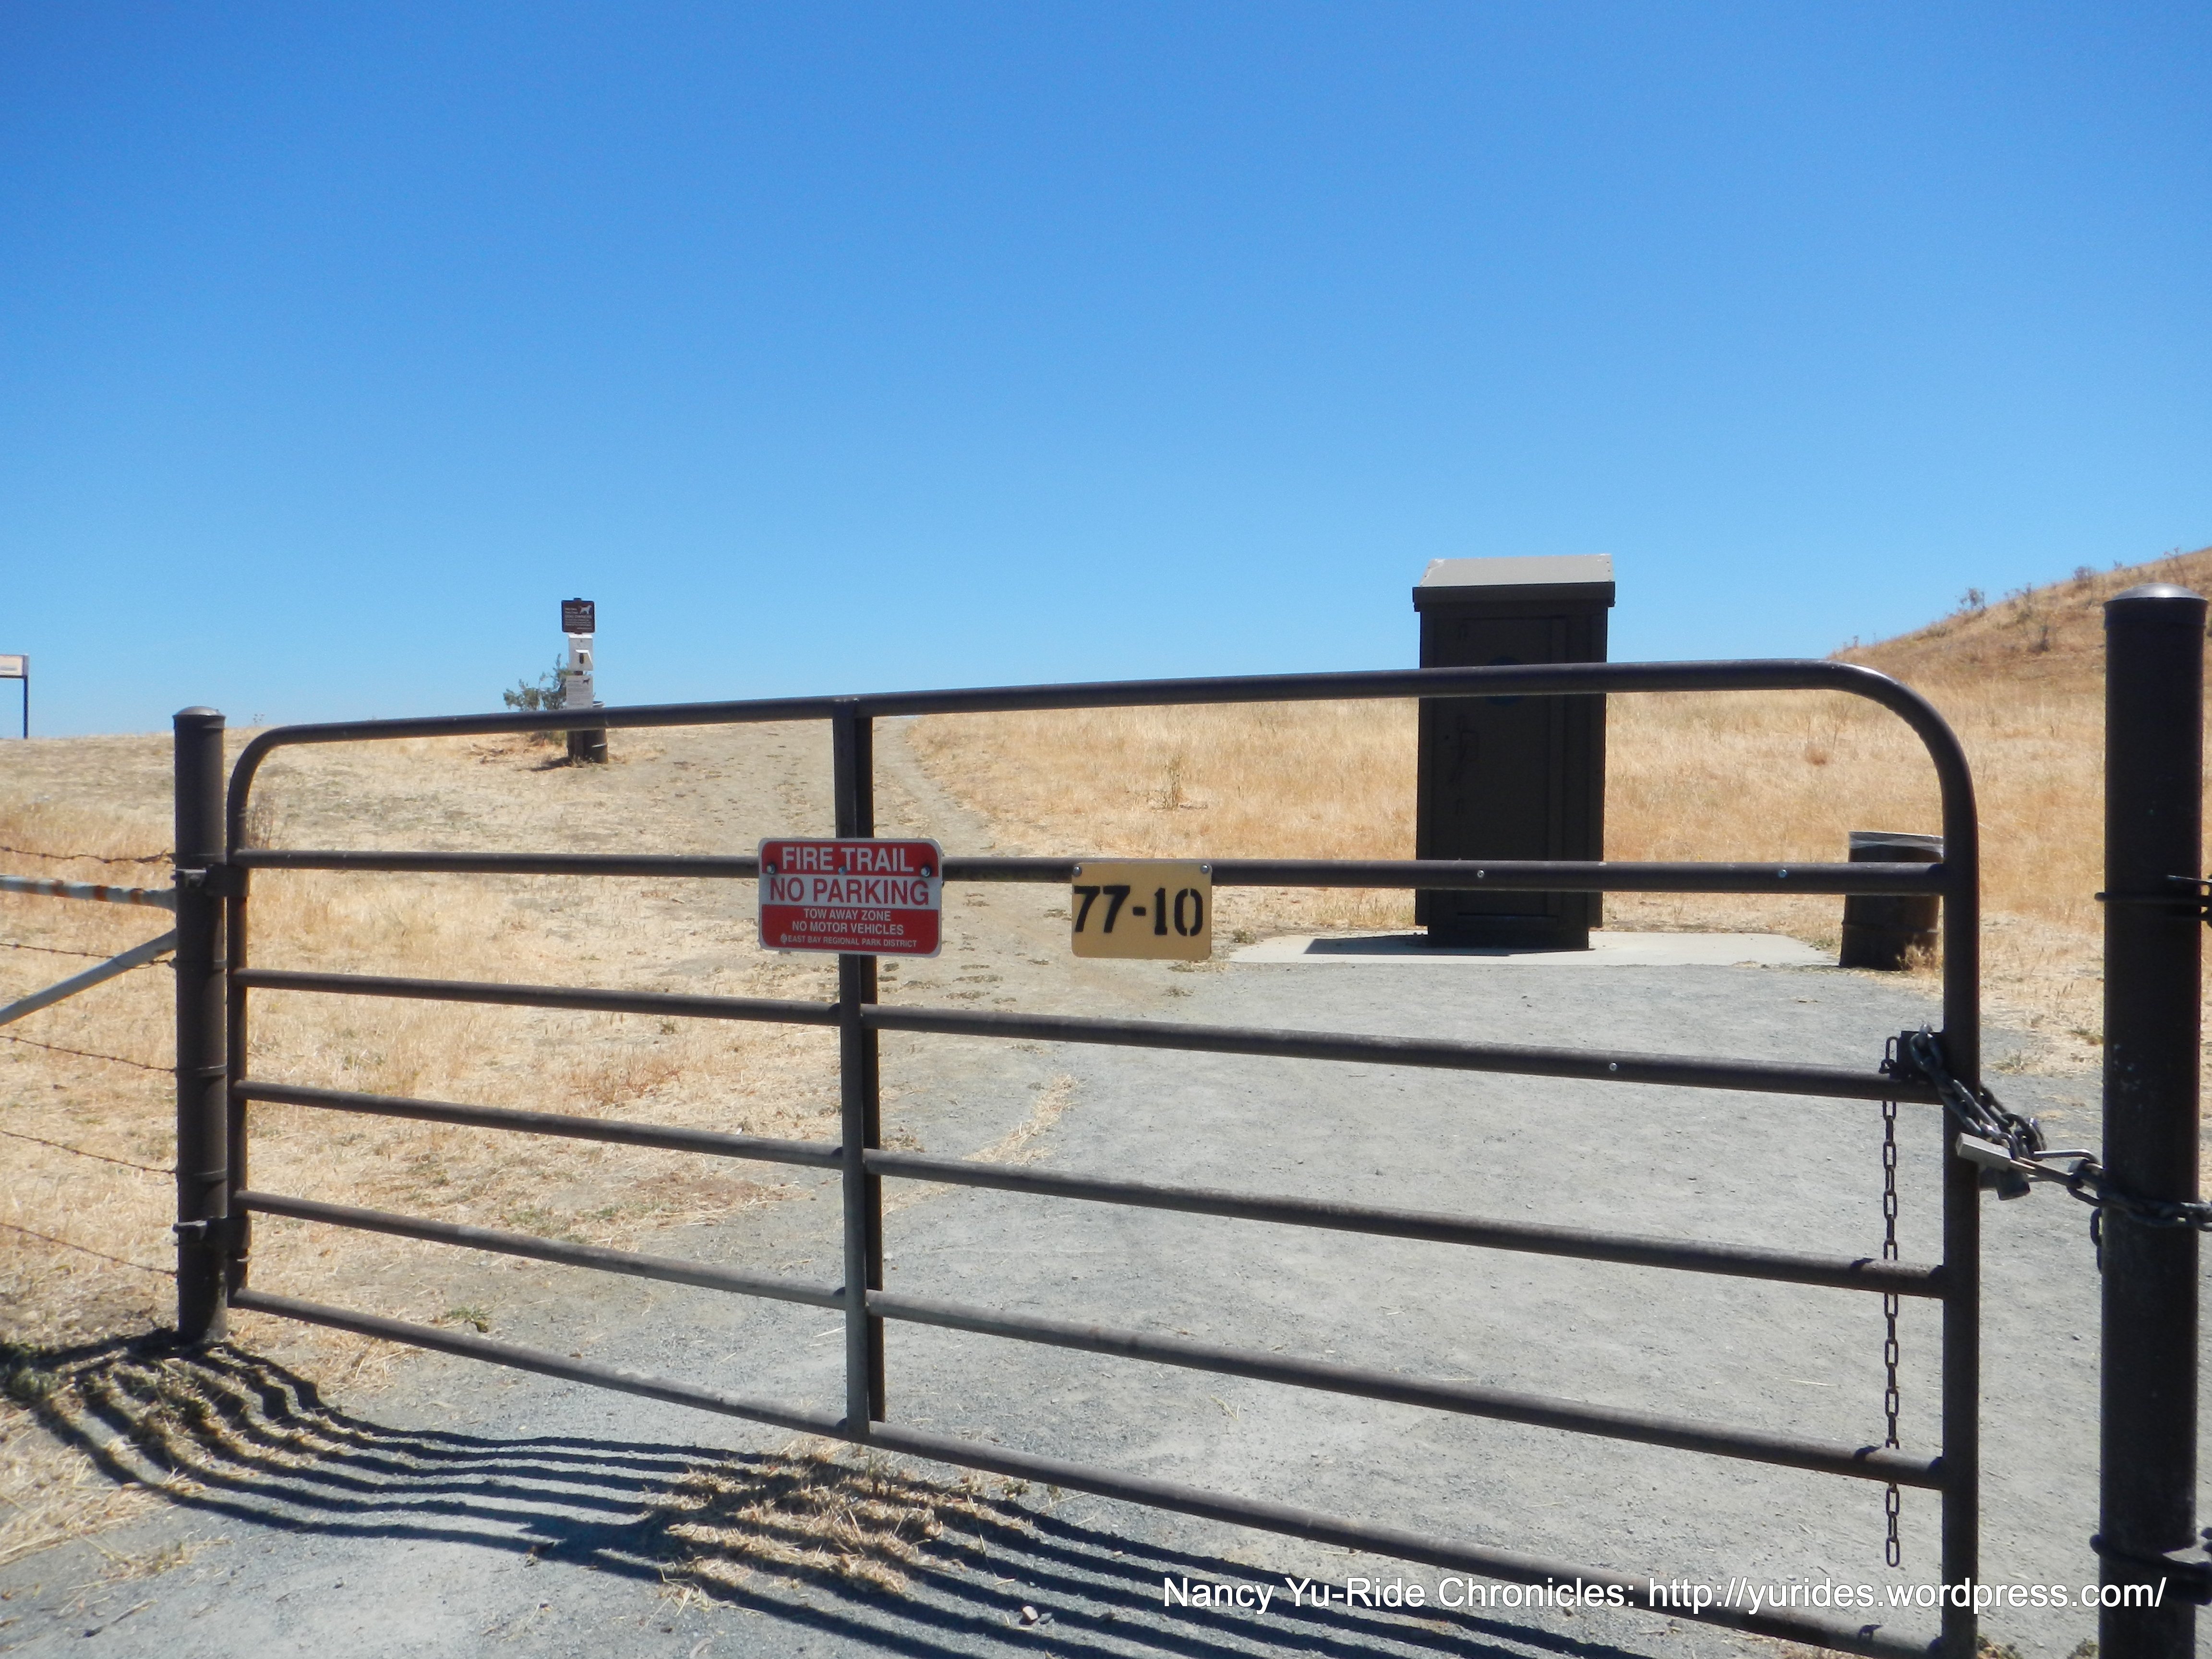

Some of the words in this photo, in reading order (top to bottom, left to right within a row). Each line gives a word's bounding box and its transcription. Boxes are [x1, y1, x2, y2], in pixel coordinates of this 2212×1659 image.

[782, 847, 834, 870] FIRE
[841, 847, 914, 872] TRAIL
[770, 877, 804, 902] NO
[813, 878, 929, 906] PARKING
[803, 908, 827, 919] TOW
[829, 909, 858, 920] AWAY
[861, 910, 891, 922] ZONE
[1074, 885, 1203, 937] 77-10
[792, 921, 807, 931] NO
[810, 922, 847, 933] MOTOR
[851, 923, 904, 936] VEHICLES
[788, 935, 805, 943] EAST
[823, 936, 859, 945] REGIONAL
[862, 938, 881, 946] PARK
[883, 939, 917, 948] DISTRICT
